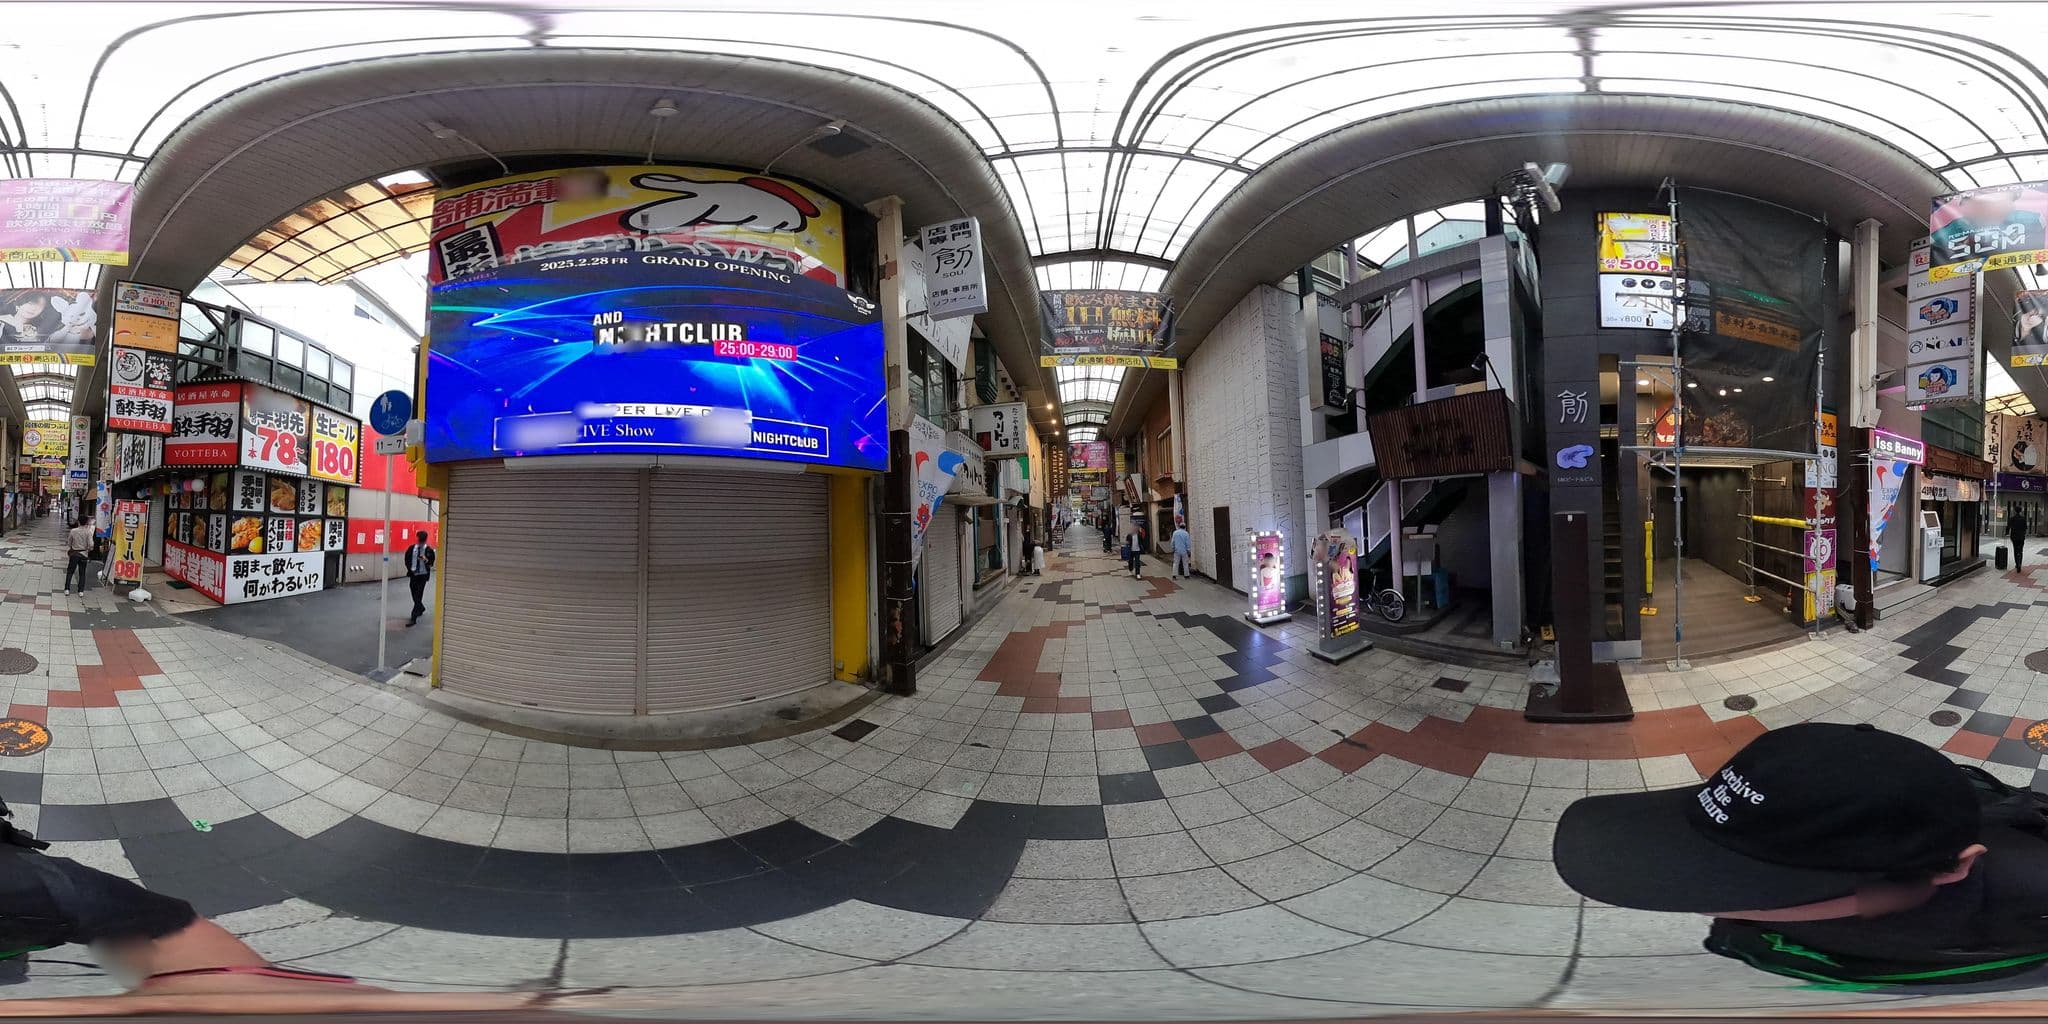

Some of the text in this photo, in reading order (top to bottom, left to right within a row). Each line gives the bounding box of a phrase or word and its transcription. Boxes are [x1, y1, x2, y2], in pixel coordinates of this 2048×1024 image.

[928, 221, 970, 237] 店舗
[928, 229, 972, 245] 専門
[540, 256, 628, 272] 2025.2.28 FR
[642, 255, 791, 284] GRAND OPENING
[933, 294, 976, 307] リフォーム
[593, 311, 623, 326] AND
[719, 341, 793, 359] 25:00-29:00
[114, 418, 167, 431] YOTTEBA
[316, 412, 355, 443] 生ビール
[615, 424, 655, 437] Show
[753, 431, 819, 450] NIGHTCLUB
[174, 447, 228, 458] YOTTEBA
[268, 519, 276, 552] イベント
[276, 519, 285, 551] 日替り
[233, 557, 305, 579] 朝まで飲んで
[243, 573, 319, 598] 何がわるい!?
[1721, 765, 1765, 804] Archive
[1713, 784, 1732, 806] the
[1697, 787, 1729, 824] future
